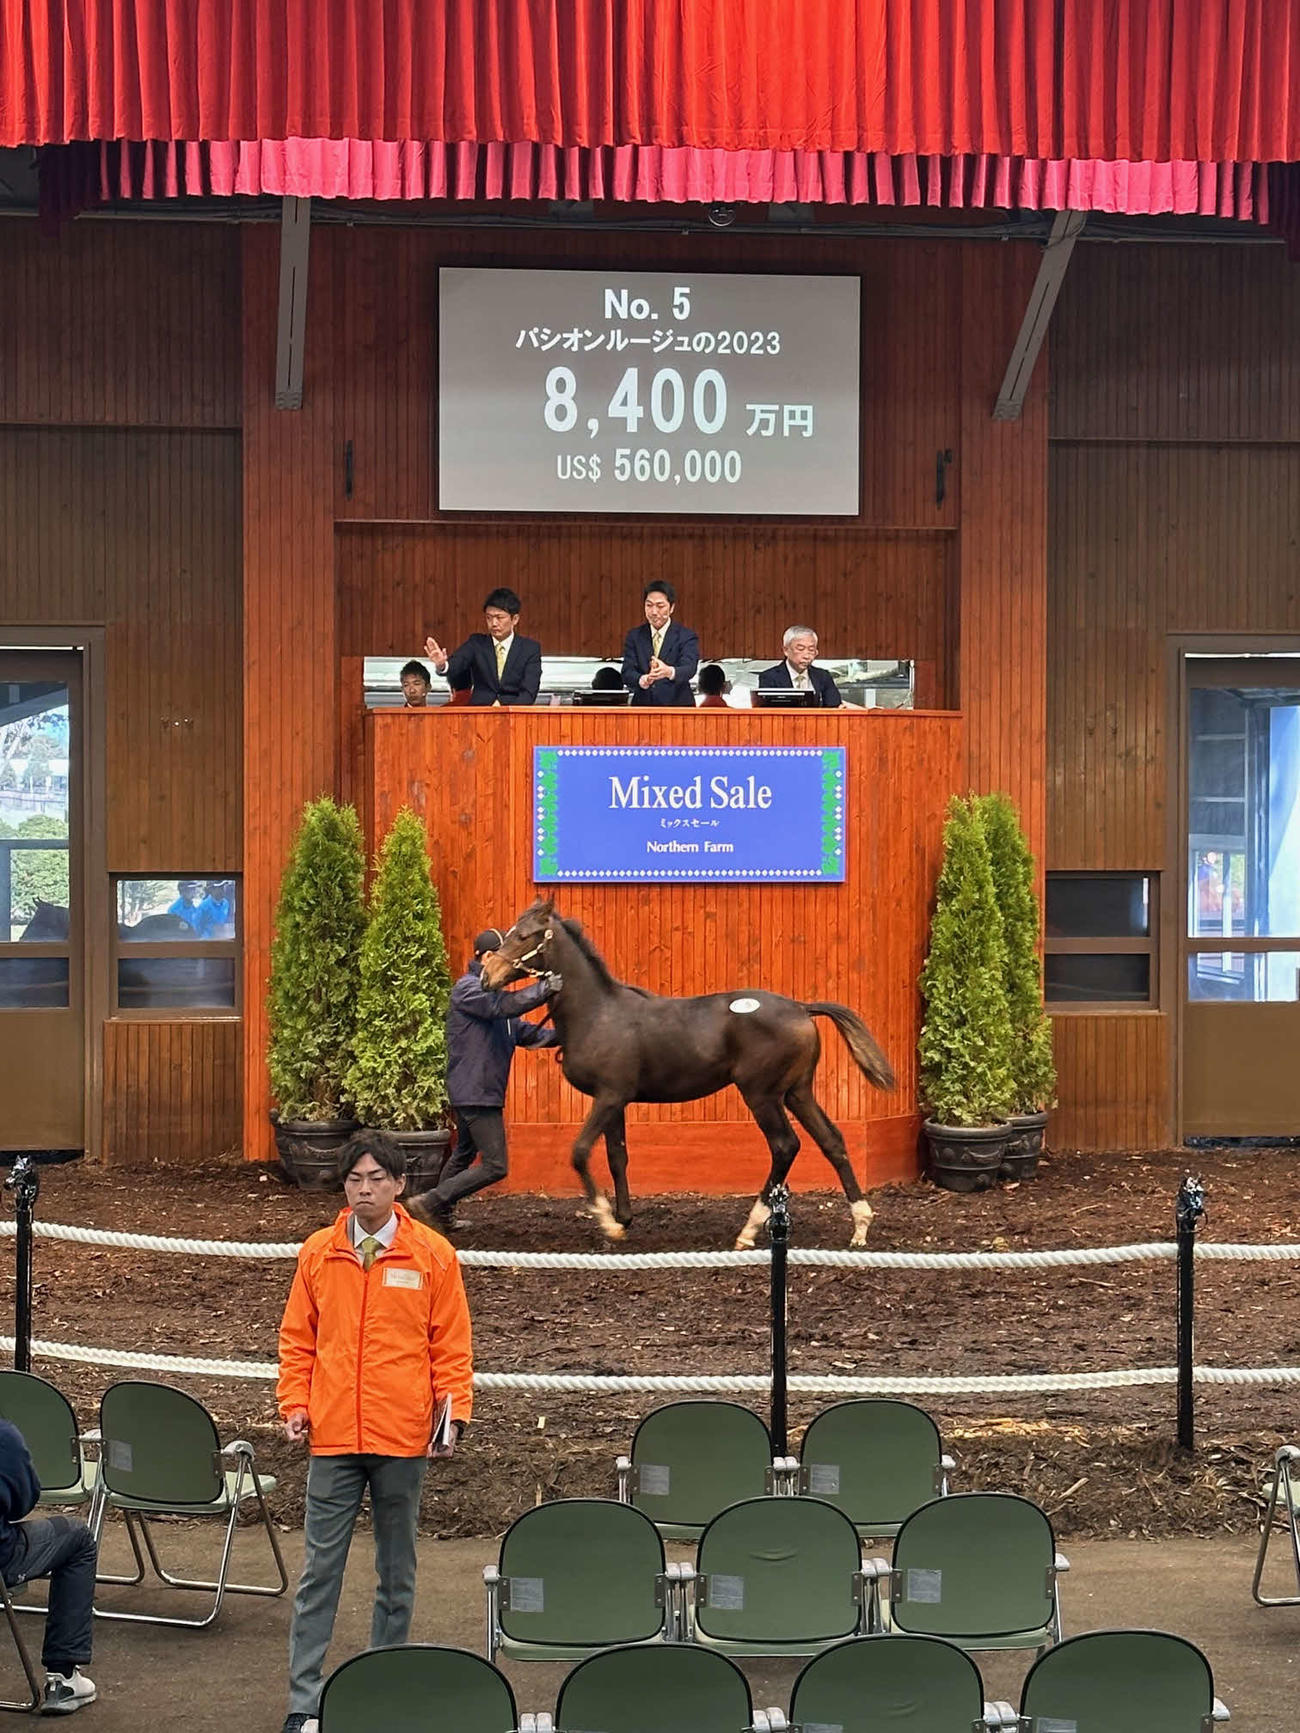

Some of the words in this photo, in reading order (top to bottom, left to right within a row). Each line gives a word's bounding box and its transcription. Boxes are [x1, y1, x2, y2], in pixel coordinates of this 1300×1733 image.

[604, 288, 659, 320] No.
[672, 286, 691, 320] 5
[515, 327, 781, 355] パシオンルージュの2023
[543, 365, 728, 439] 8,400
[745, 404, 814, 437] 万円
[556, 453, 601, 484] US$
[614, 448, 742, 485] 560,000
[608, 775, 703, 809] Mixed
[710, 775, 772, 809] Sale
[659, 817, 720, 828] ミックスセール
[646, 840, 699, 853] Northern
[704, 841, 734, 853] Farm
